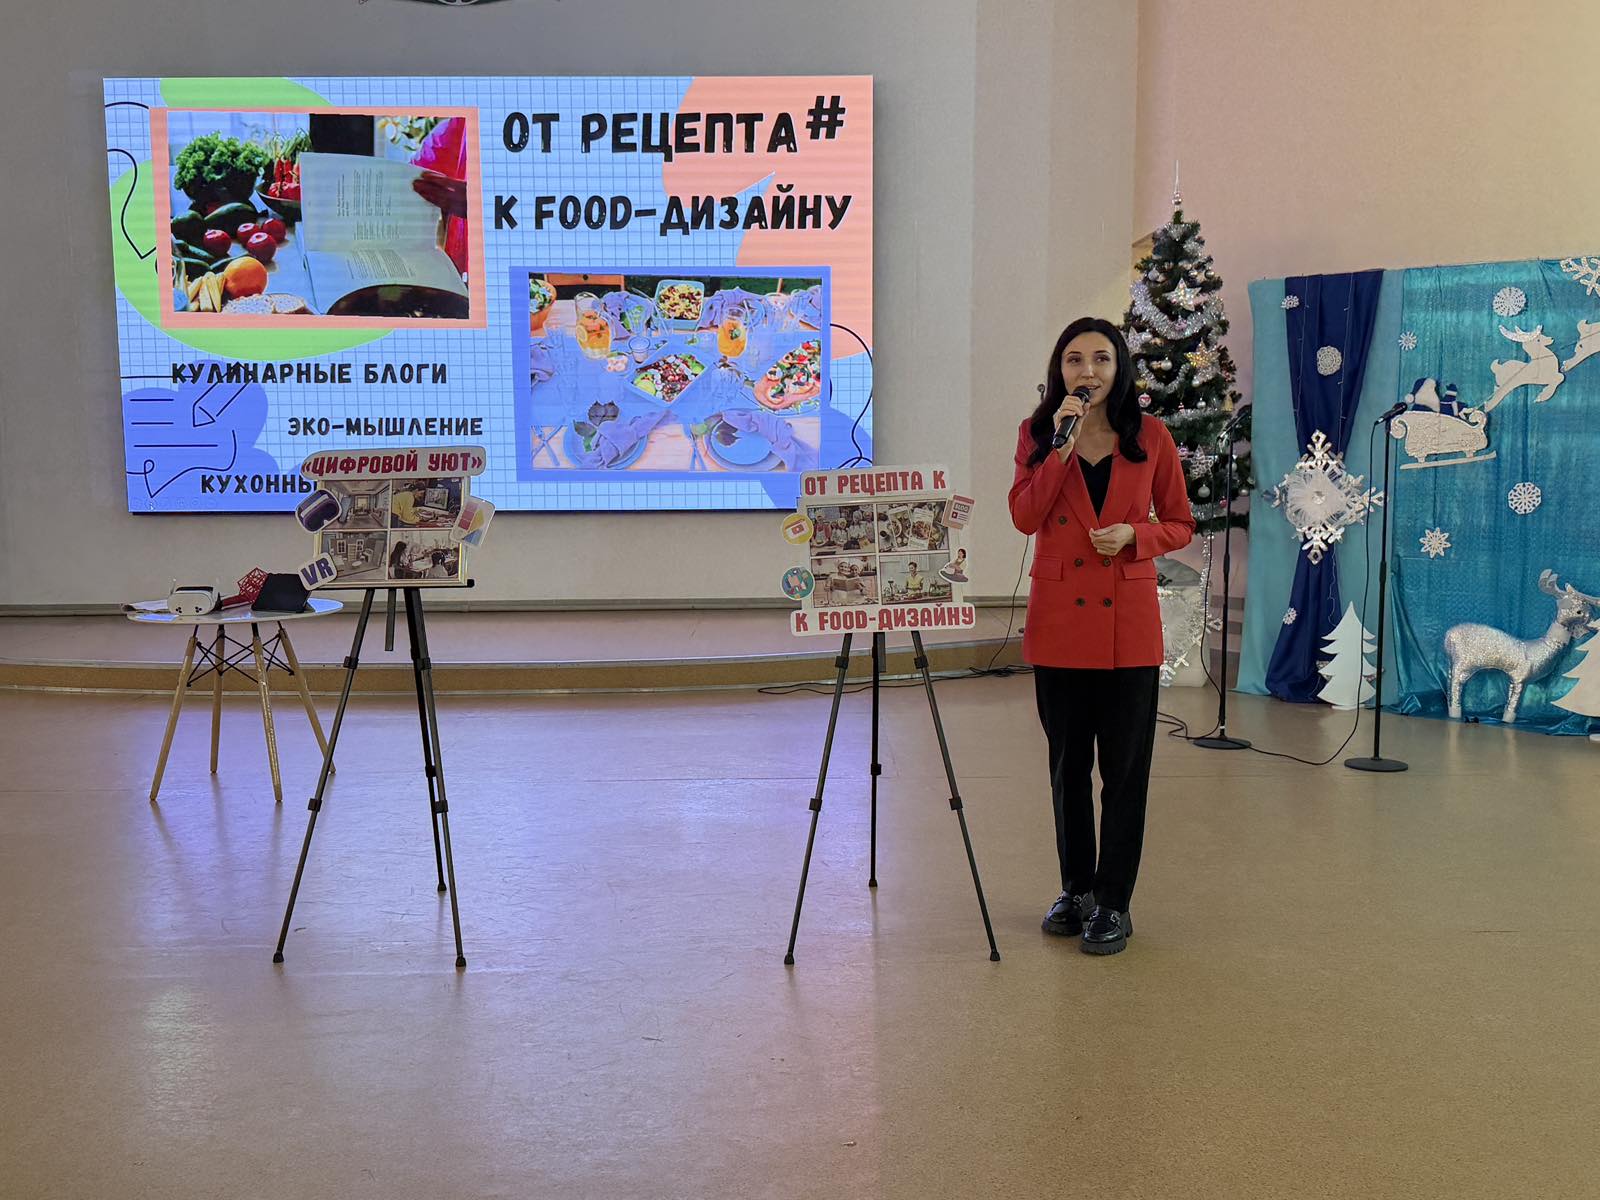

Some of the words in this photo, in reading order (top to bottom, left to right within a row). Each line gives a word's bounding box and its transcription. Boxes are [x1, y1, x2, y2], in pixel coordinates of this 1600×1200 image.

[503, 112, 560, 153] ОТ
[581, 112, 798, 162] РЕЦЕПТА
[494, 195, 518, 229] К
[534, 184, 852, 236] FOOD-ДИЗАЙНУ
[172, 363, 352, 384] КУЛИНАРНЫЕ
[364, 363, 447, 384] БЛОГИ
[287, 417, 483, 436] ЭКО-МЫШЛЕНИЕ
[302, 450, 418, 476] «ЦИФРОВОЙ
[428, 452, 482, 472] УЮТ»
[804, 476, 827, 496] ОТ
[837, 471, 923, 496] РЕЦЕПТА
[933, 470, 946, 490] К
[301, 557, 334, 586] VR
[795, 612, 808, 632] К
[818, 603, 974, 631] FOOD-ДИЗАЙНУ
